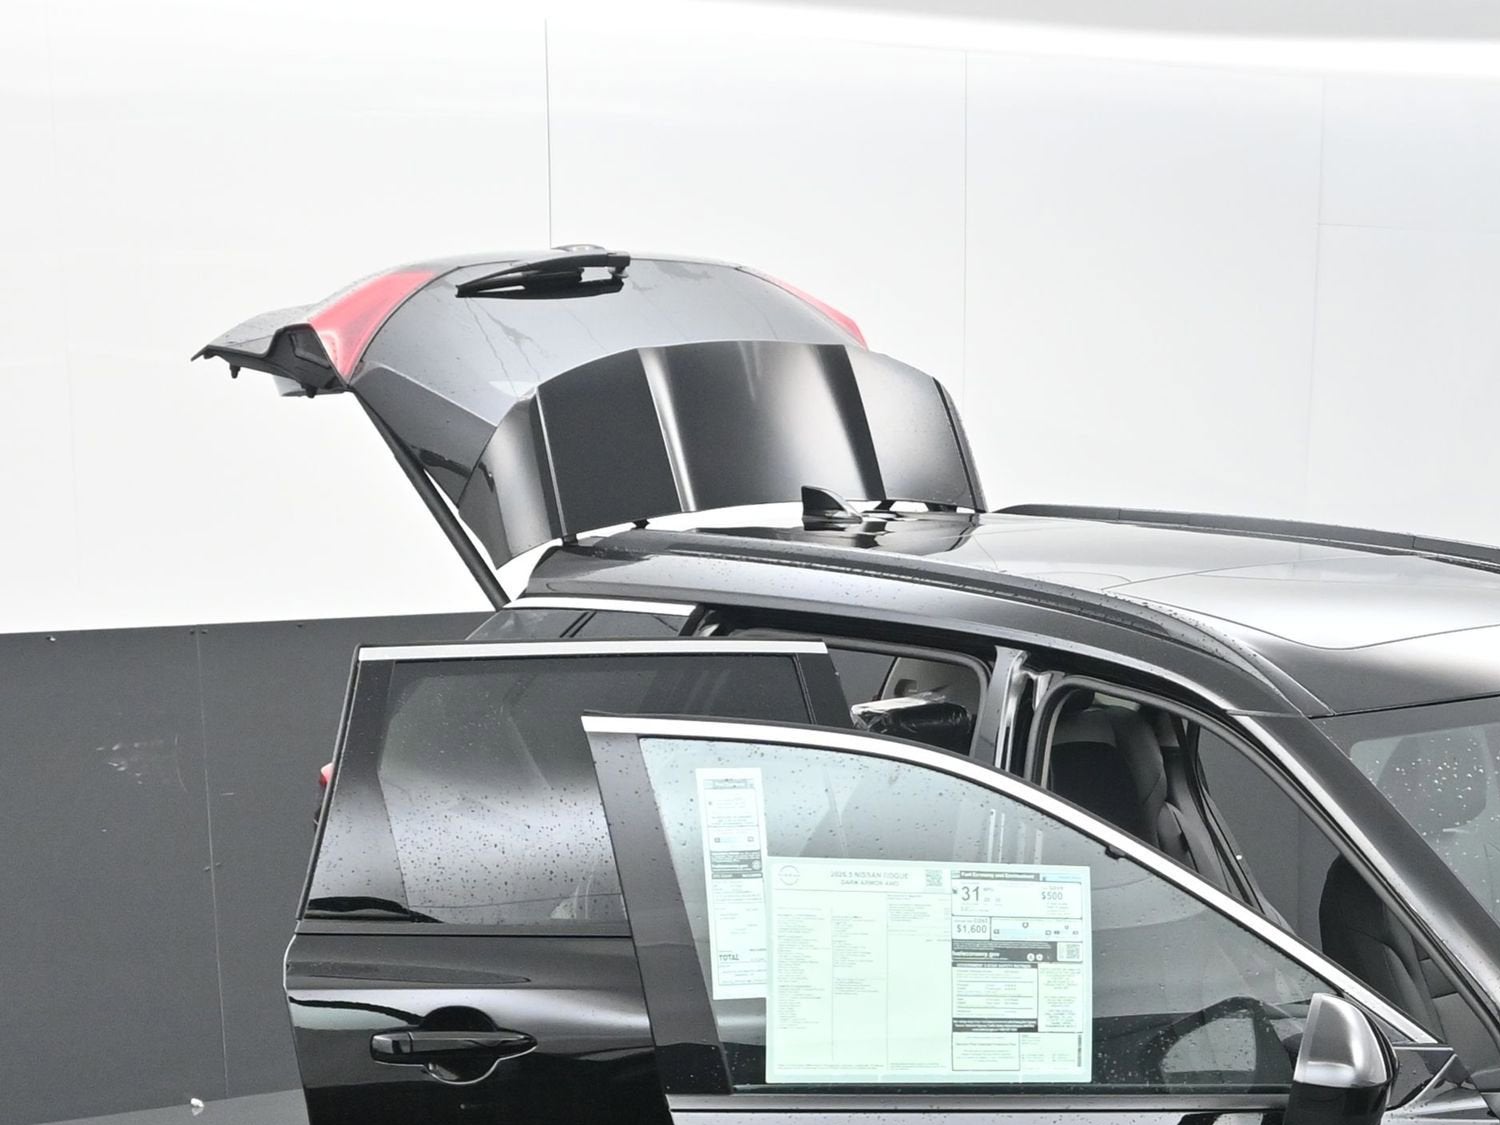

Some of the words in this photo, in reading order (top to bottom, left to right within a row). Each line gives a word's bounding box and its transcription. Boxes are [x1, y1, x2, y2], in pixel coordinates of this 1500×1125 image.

[961, 886, 980, 901] 31
[1041, 890, 1064, 900] $500
[956, 924, 988, 934] $1,600
